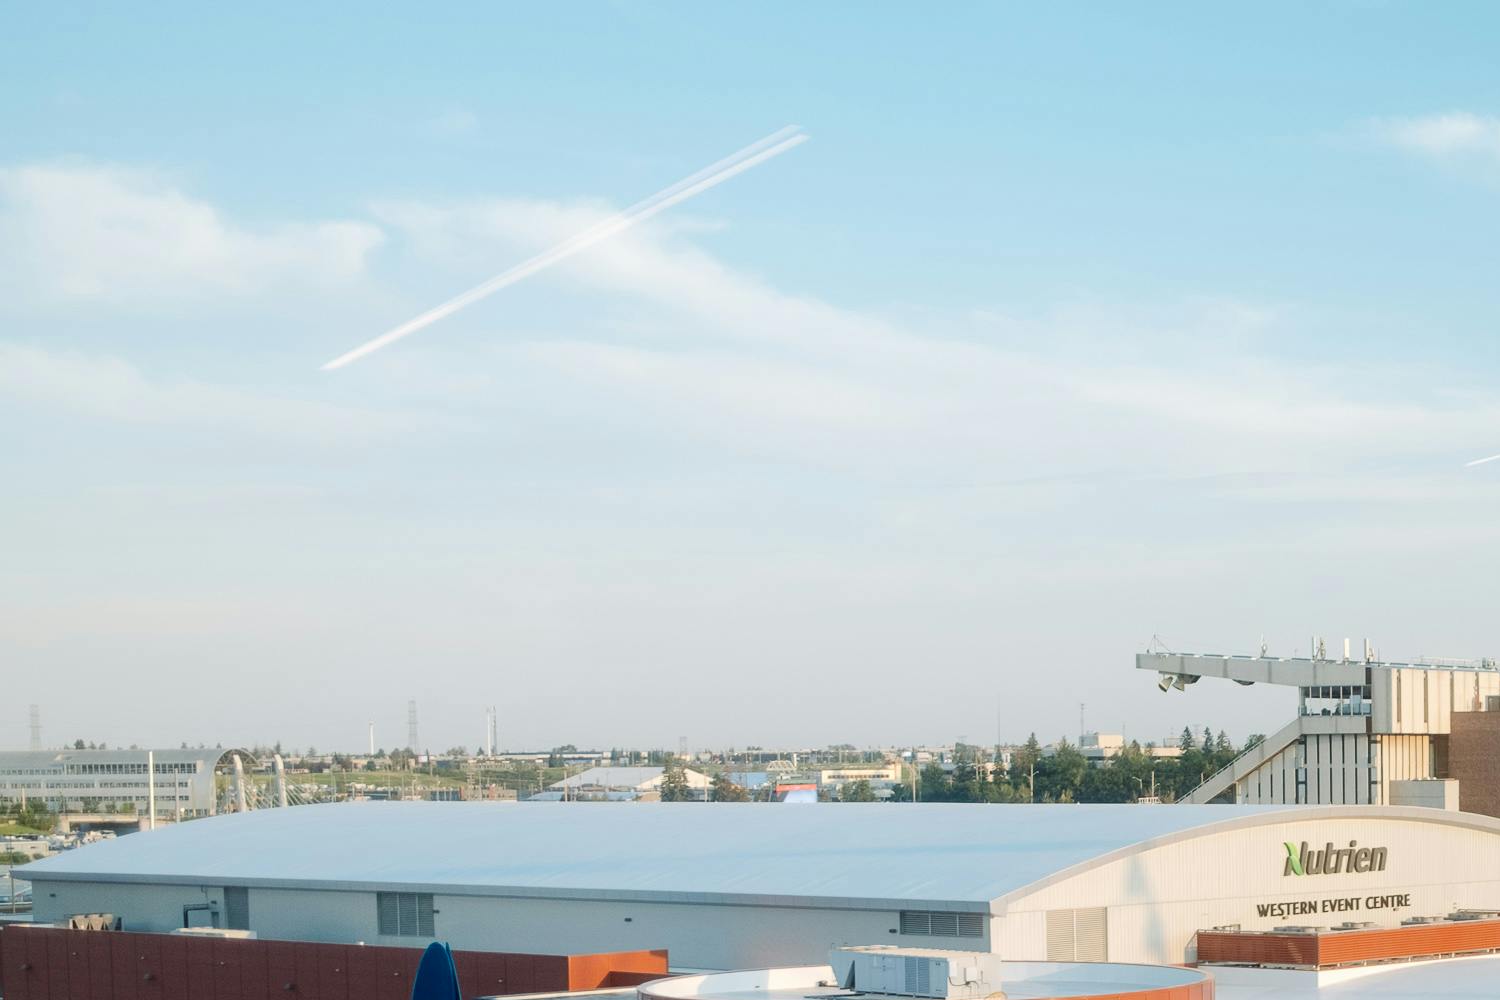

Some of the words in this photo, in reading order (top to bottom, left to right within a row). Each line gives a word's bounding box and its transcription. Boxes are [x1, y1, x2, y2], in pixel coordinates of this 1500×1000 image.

[1283, 840, 1388, 876] Nutrien
[1257, 901, 1318, 918] WESTERN
[1322, 898, 1362, 913] EVENT
[1366, 894, 1411, 909] CENTRE
